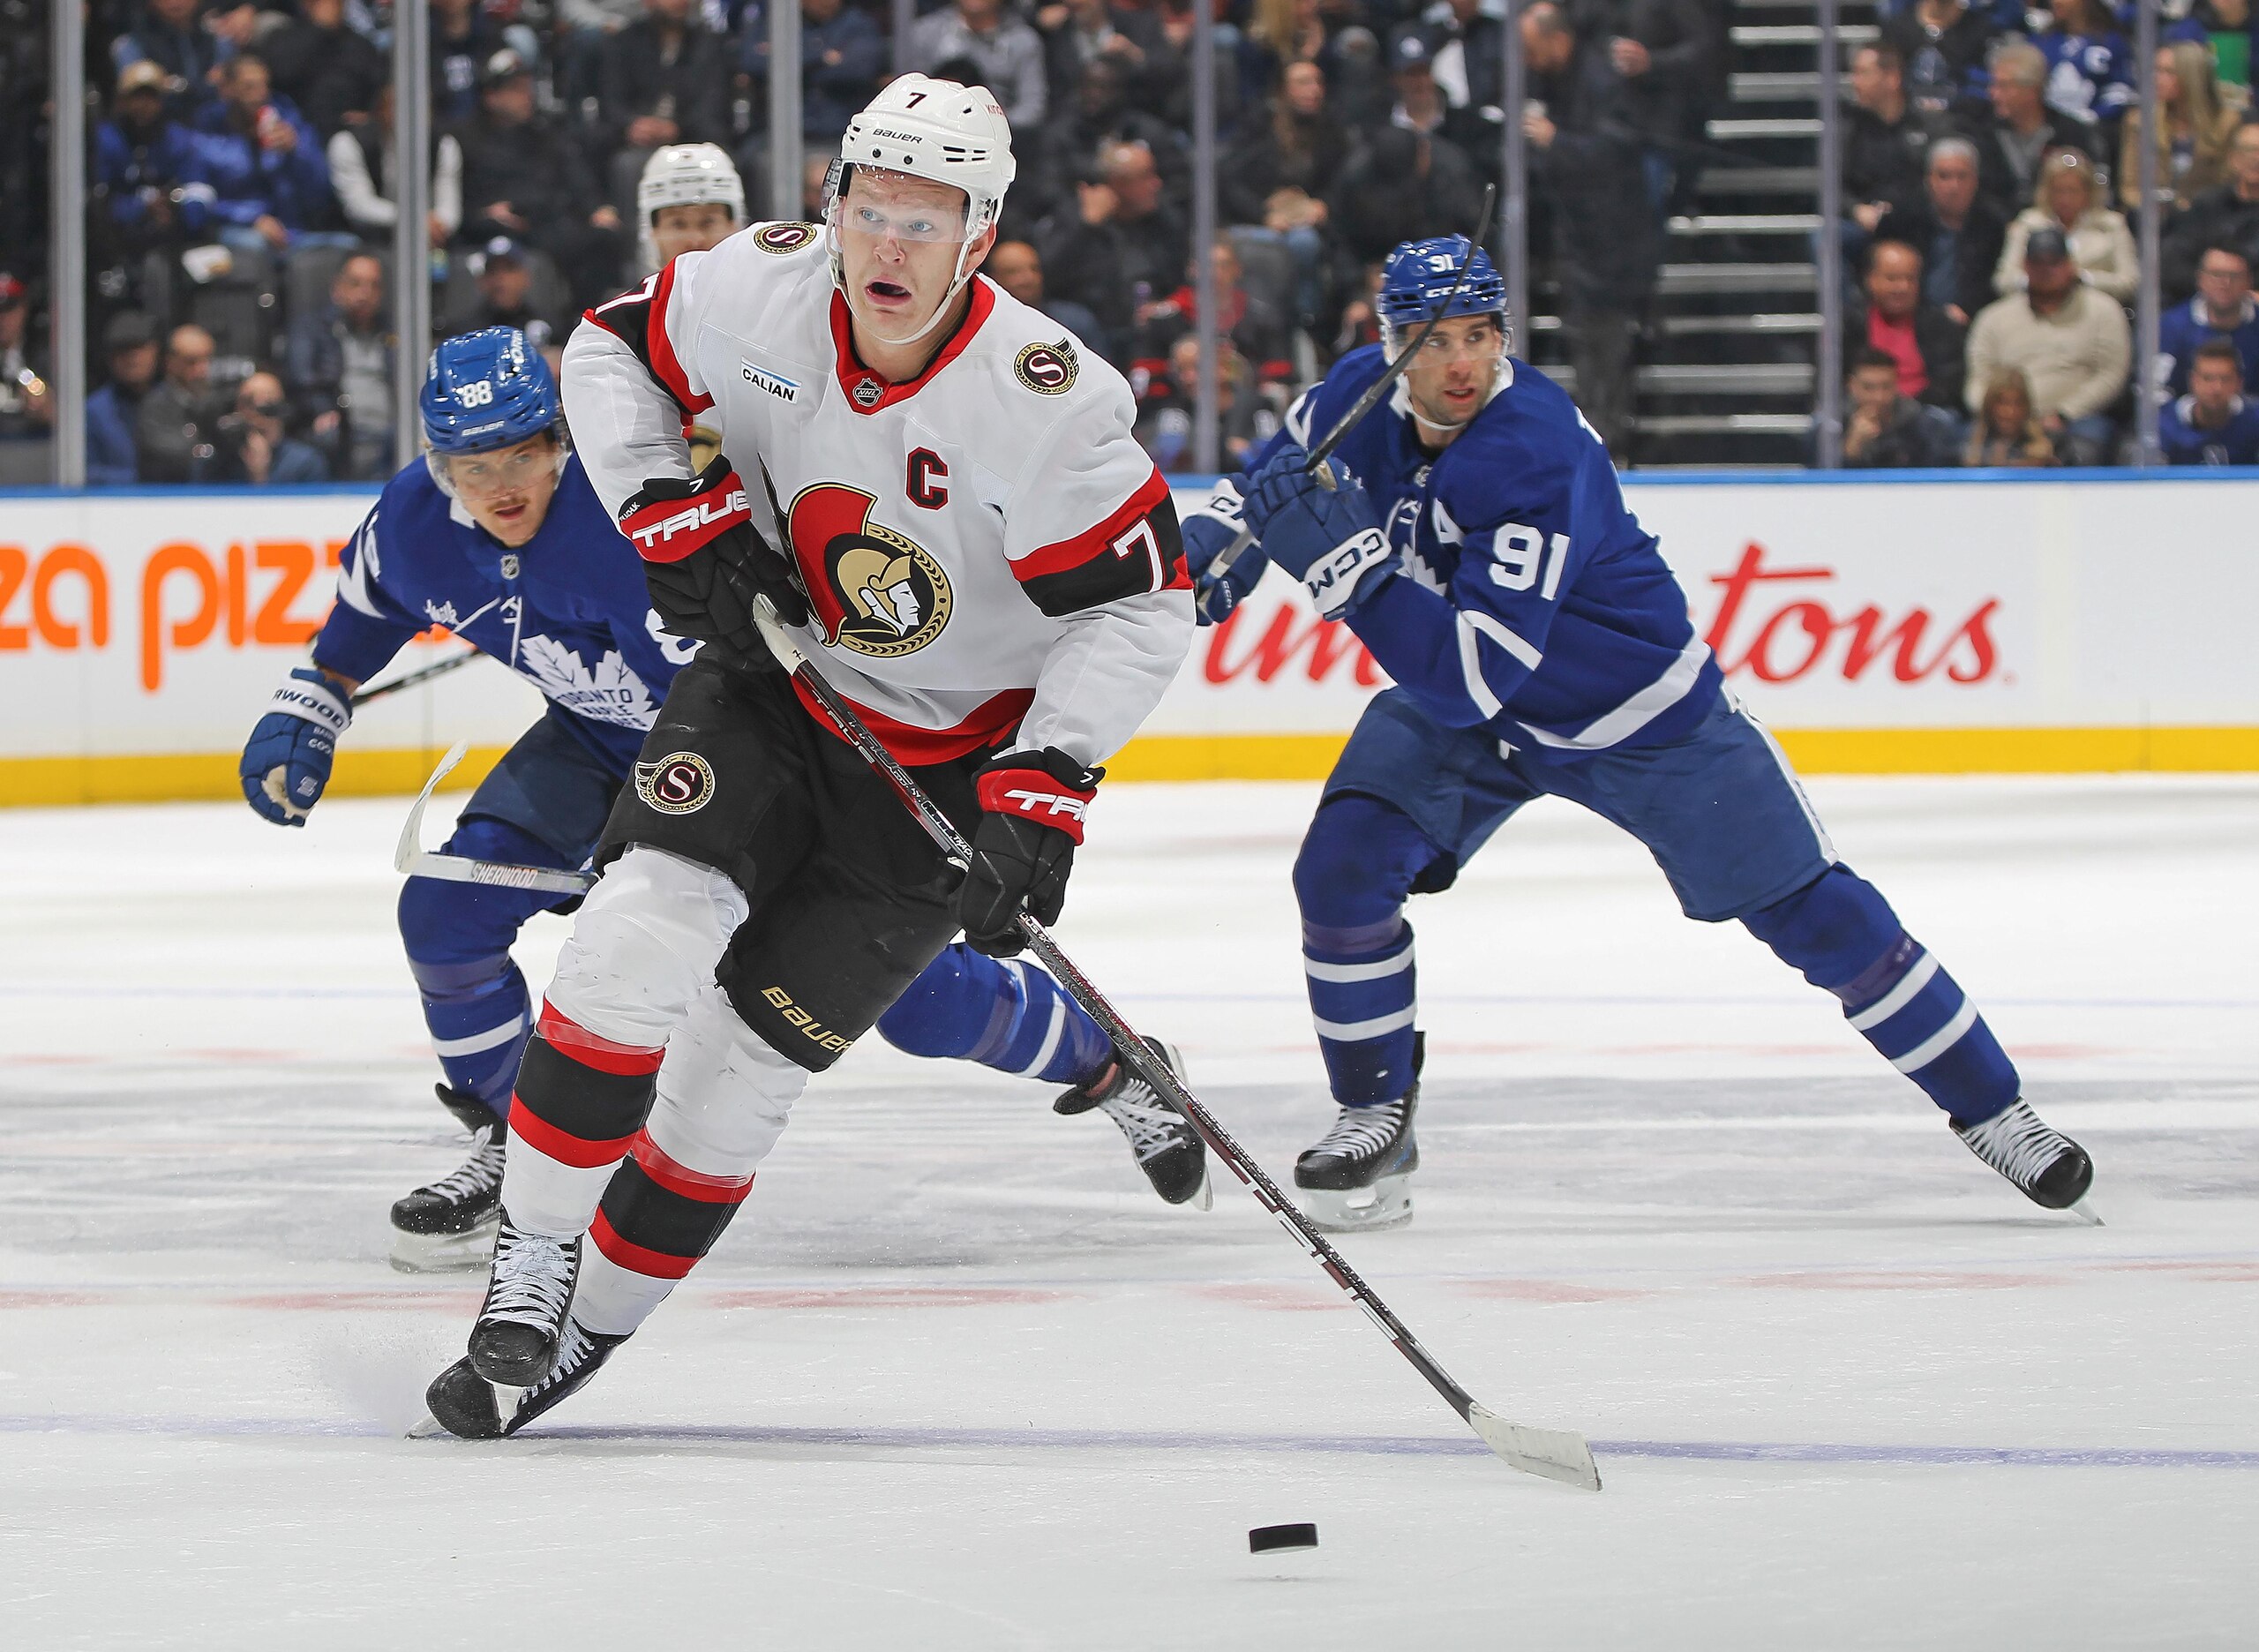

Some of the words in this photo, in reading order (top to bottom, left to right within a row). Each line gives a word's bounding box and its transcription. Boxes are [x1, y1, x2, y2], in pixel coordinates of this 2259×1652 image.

[905, 92, 928, 109] 7
[1428, 253, 1456, 274] 91
[1425, 284, 1472, 299] CCM
[741, 368, 796, 402] CALIAN
[1028, 351, 1065, 386] S
[462, 379, 493, 409] 88
[688, 477, 705, 493] 7
[905, 447, 949, 511] C
[631, 490, 752, 548] TRUE
[1110, 515, 1166, 593] 7
[1308, 531, 1385, 599] CCM
[1488, 522, 1572, 601] 91
[1205, 604, 1377, 687] im
[1703, 544, 1999, 681] tons
[811, 688, 876, 765] TRUE
[660, 765, 696, 801] S
[1079, 770, 1094, 784] 7
[470, 861, 540, 889] SHERWOOD
